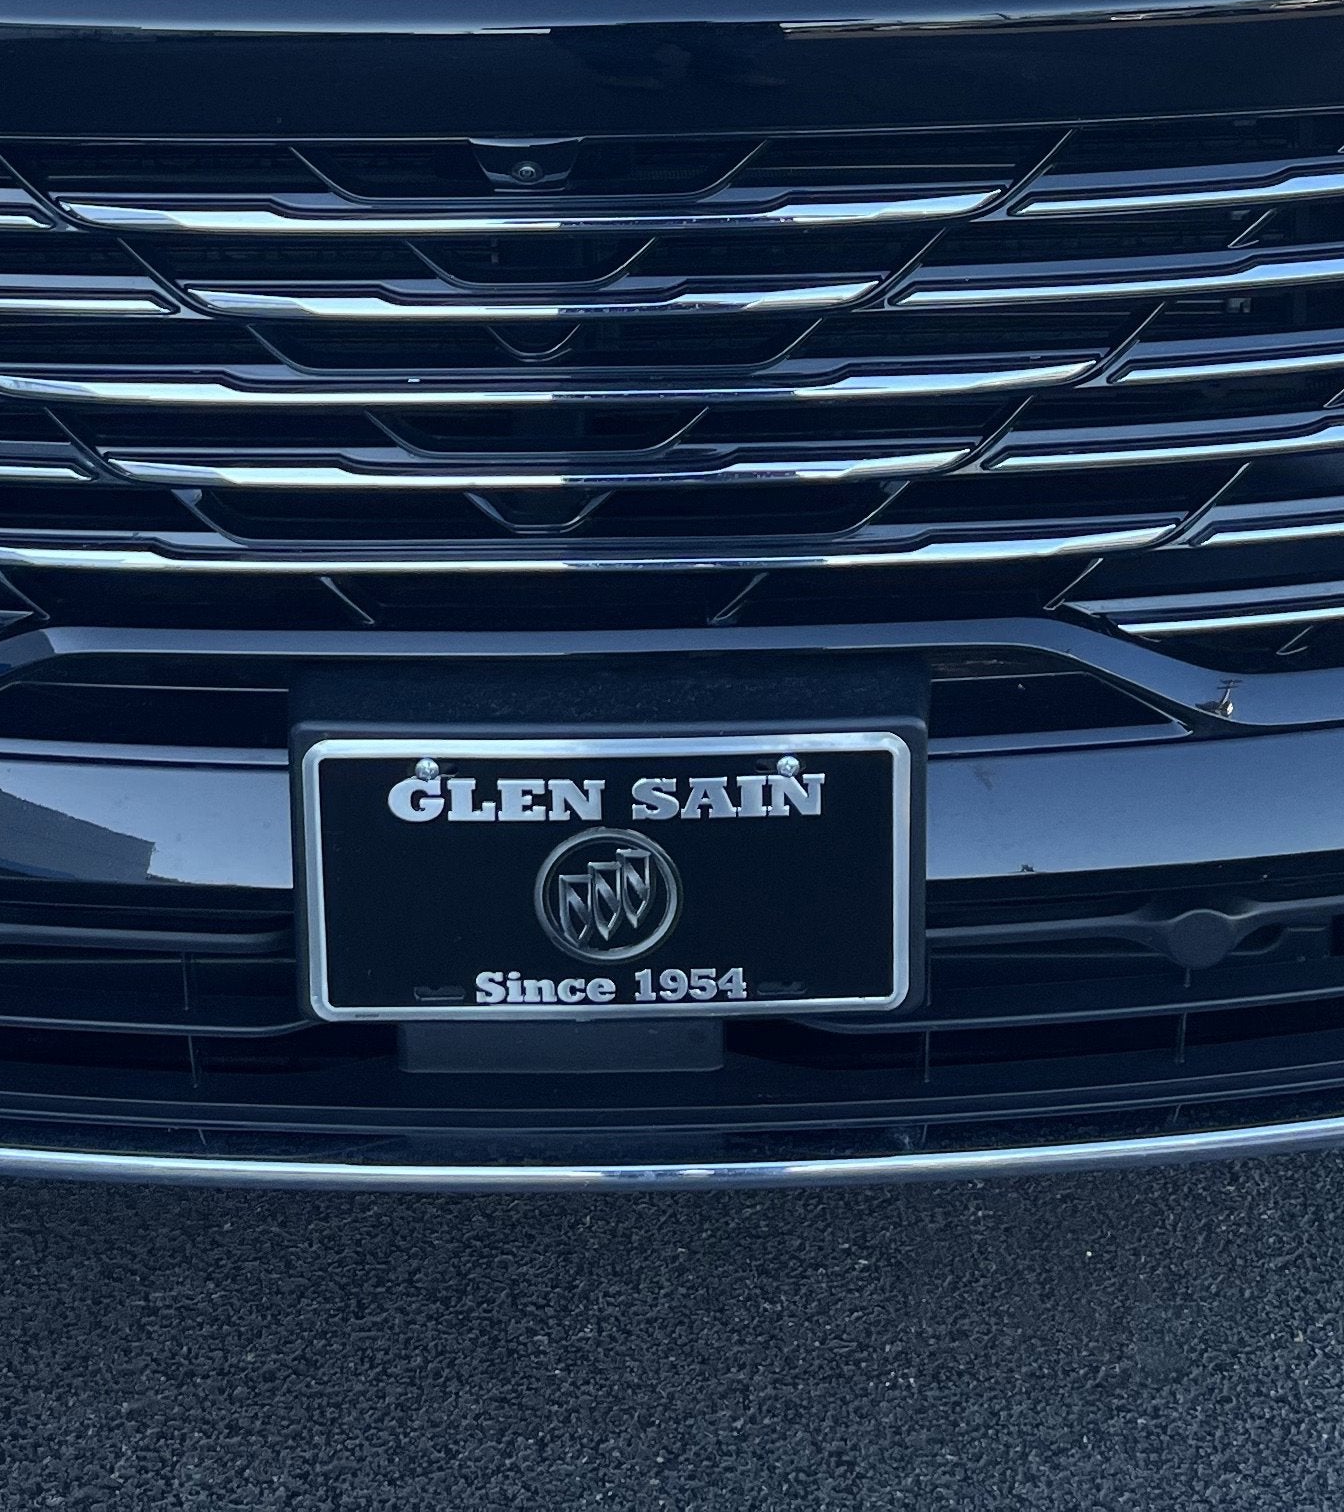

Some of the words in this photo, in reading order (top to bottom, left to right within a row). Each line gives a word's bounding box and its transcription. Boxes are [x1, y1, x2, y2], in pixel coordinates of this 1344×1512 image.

[387, 775, 605, 823] GLEN
[630, 772, 827, 822] SAIN
[474, 968, 617, 1006] Since
[633, 967, 748, 1003] 1954
